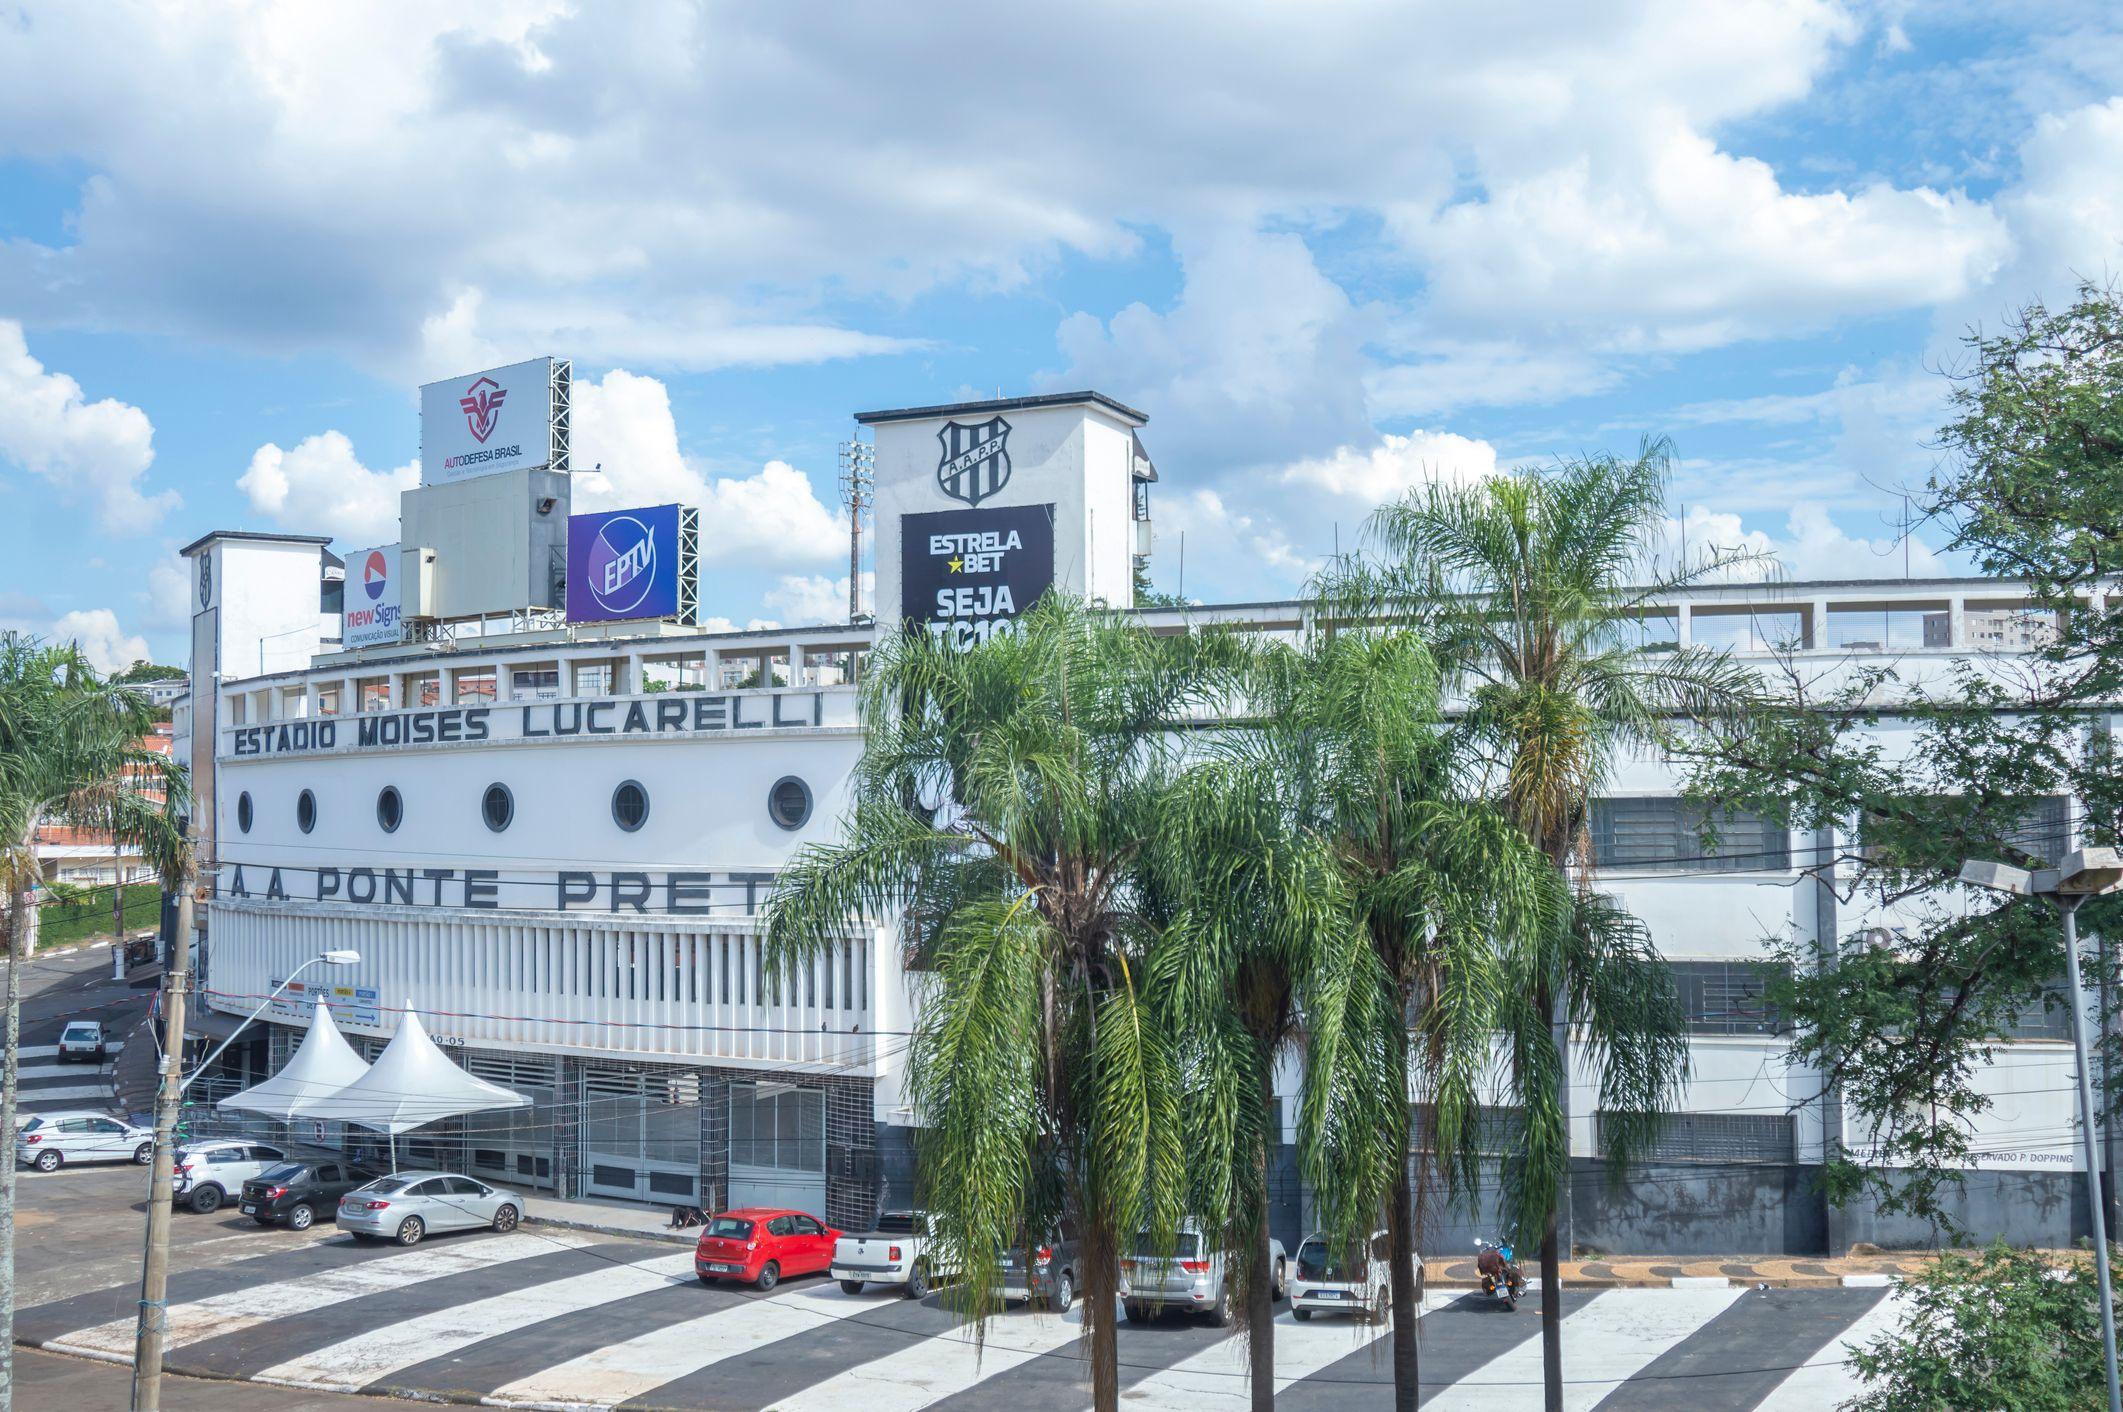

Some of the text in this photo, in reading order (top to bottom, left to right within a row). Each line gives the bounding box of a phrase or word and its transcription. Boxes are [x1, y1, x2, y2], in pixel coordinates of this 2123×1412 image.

[444, 445, 522, 469] AUTODEFESA BRASIL
[930, 530, 1022, 555] ESTRELA
[605, 525, 655, 595] EPTV
[964, 551, 1005, 573] BET
[937, 585, 1015, 617] SEJA
[384, 629, 399, 640] VISUAL
[235, 692, 824, 755] ESTADIO MOISES LUCARELLI
[317, 867, 498, 908] PONTE
[558, 871, 775, 915] PRET
[2030, 1153, 2074, 1163] DOPPING
